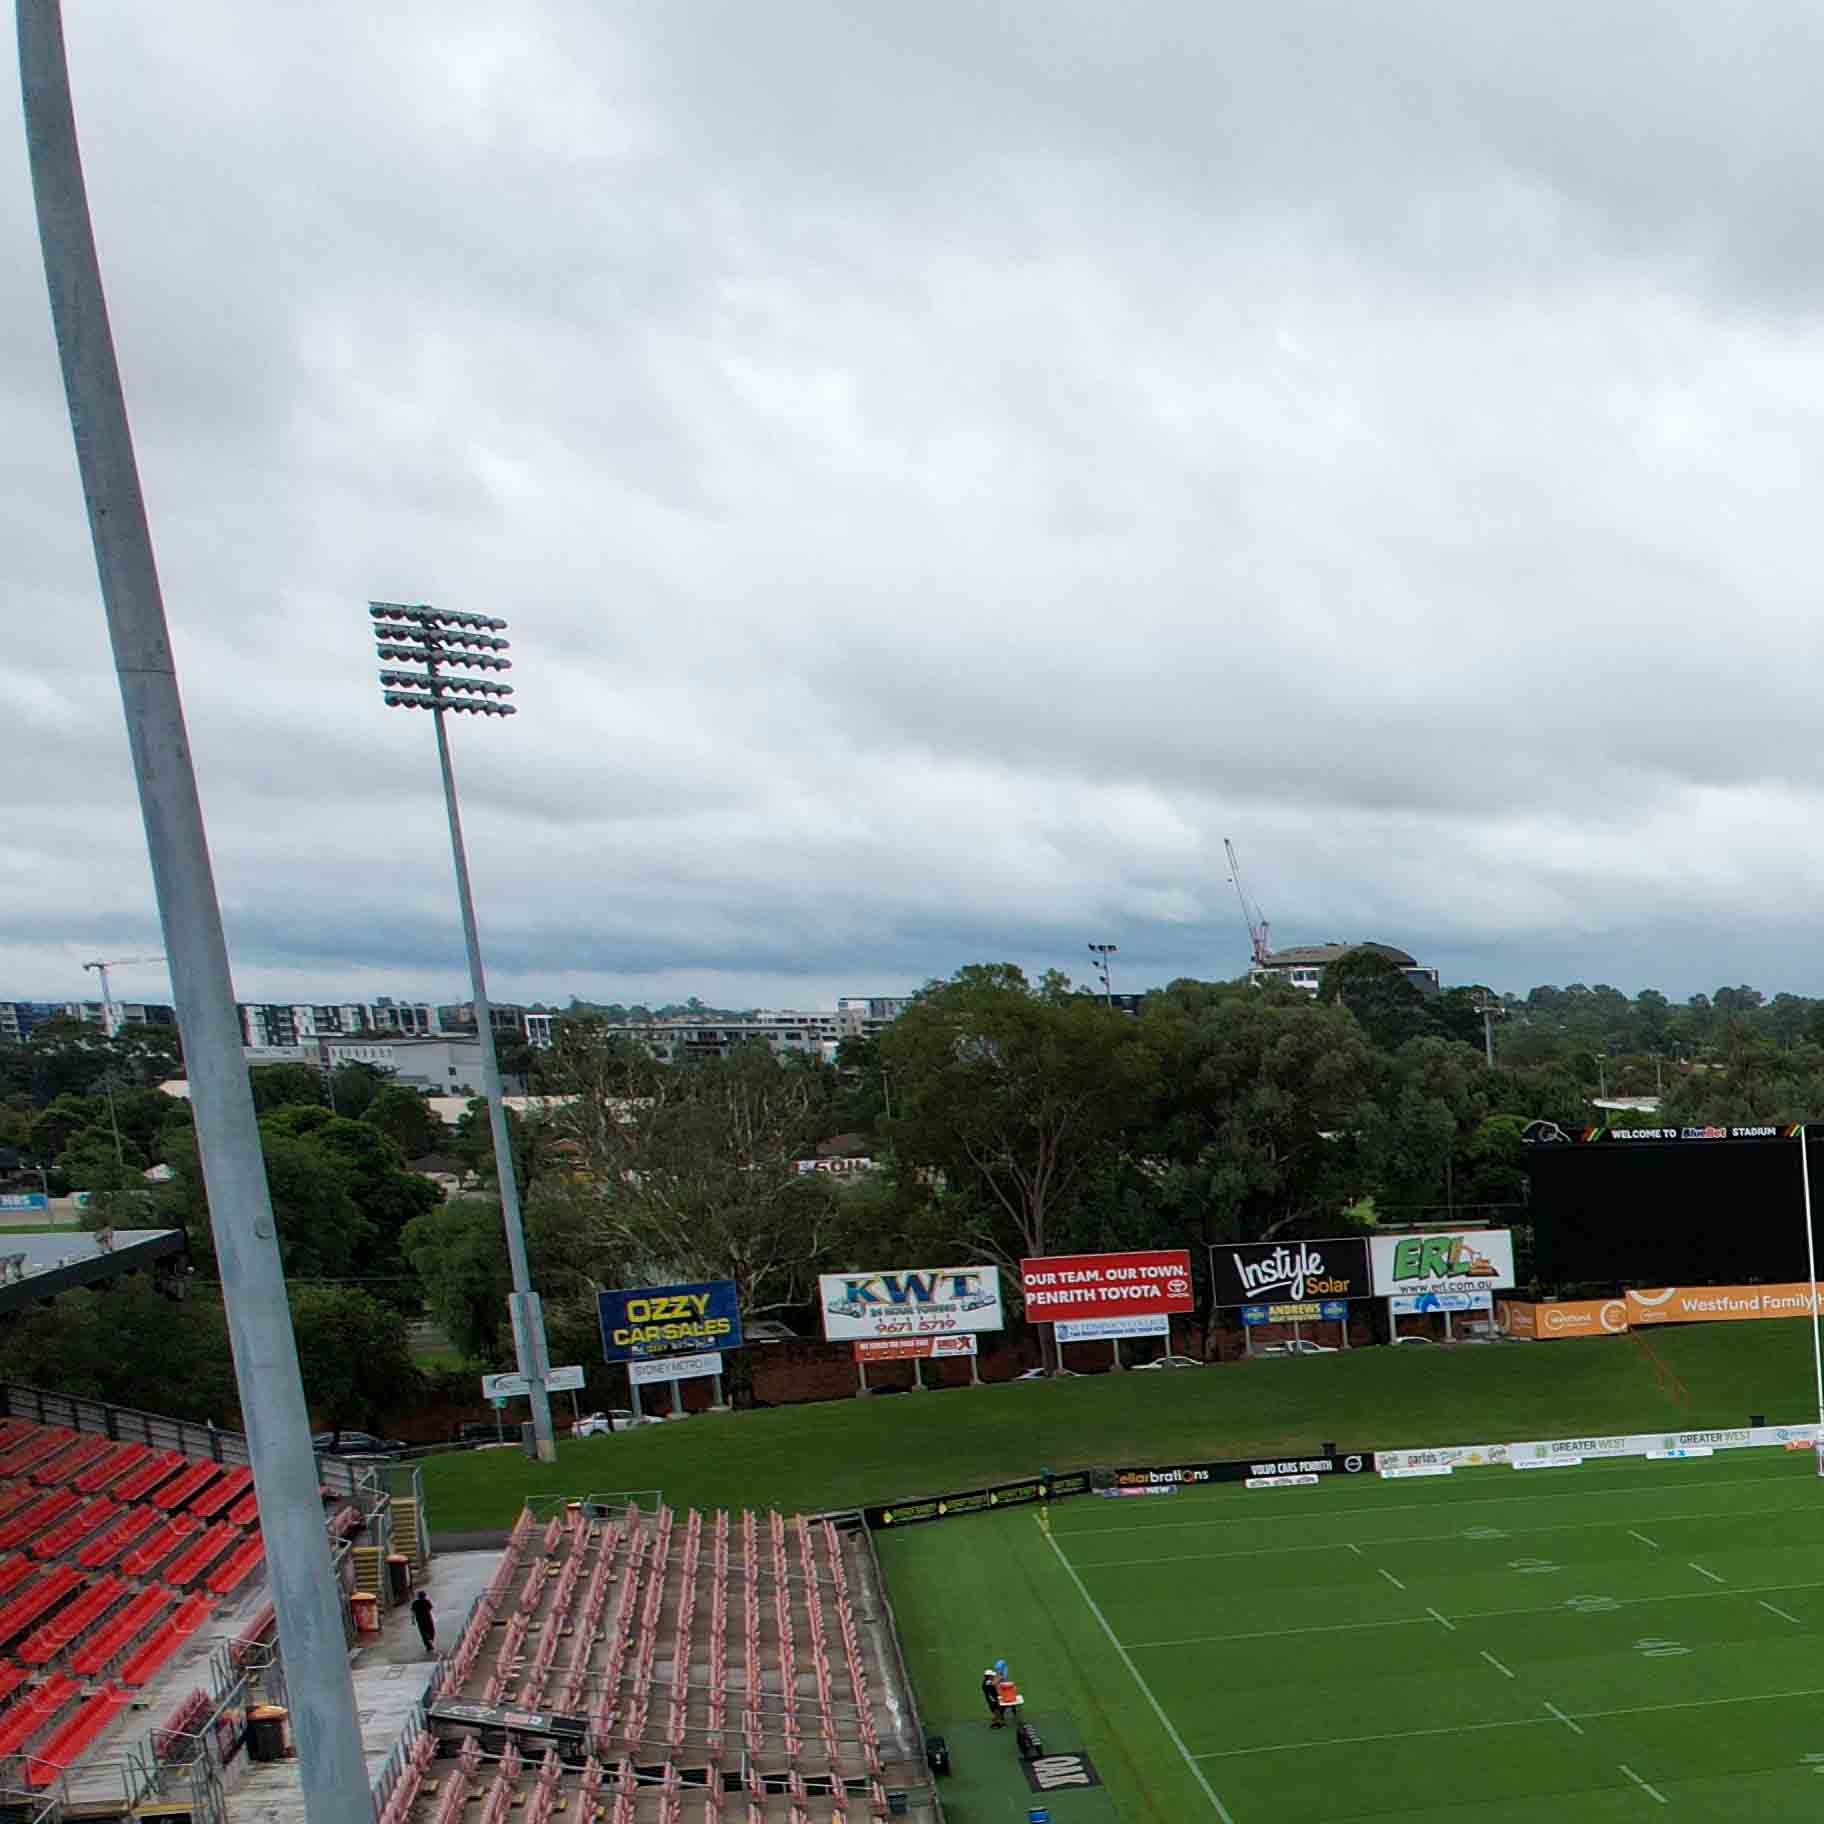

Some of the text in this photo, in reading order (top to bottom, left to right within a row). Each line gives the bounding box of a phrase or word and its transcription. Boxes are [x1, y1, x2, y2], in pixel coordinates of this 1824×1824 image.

[1611, 1129, 1660, 1139] WELCOME
[1662, 1128, 1677, 1138] TO
[1732, 1126, 1777, 1137] STADIUM
[1393, 1235, 1474, 1282] ERL
[1024, 1265, 1188, 1286] OUR TEAM. OUR TOWN.
[1233, 1243, 1325, 1300] Instyle
[844, 1273, 981, 1303] KWT
[1026, 1285, 1161, 1305] PENRITH TOYOTA
[1306, 1278, 1351, 1296] Solar
[626, 1293, 711, 1323] OZZY
[1681, 1294, 1760, 1313] Westfund
[1762, 1292, 1814, 1314] Family
[661, 1317, 731, 1341] SALES
[1551, 1439, 1625, 1453] GREATER WEST
[1679, 1430, 1751, 1444] GREATER WEST
[1277, 1462, 1298, 1473] CARS
[1031, 1755, 1091, 1789] OAK
